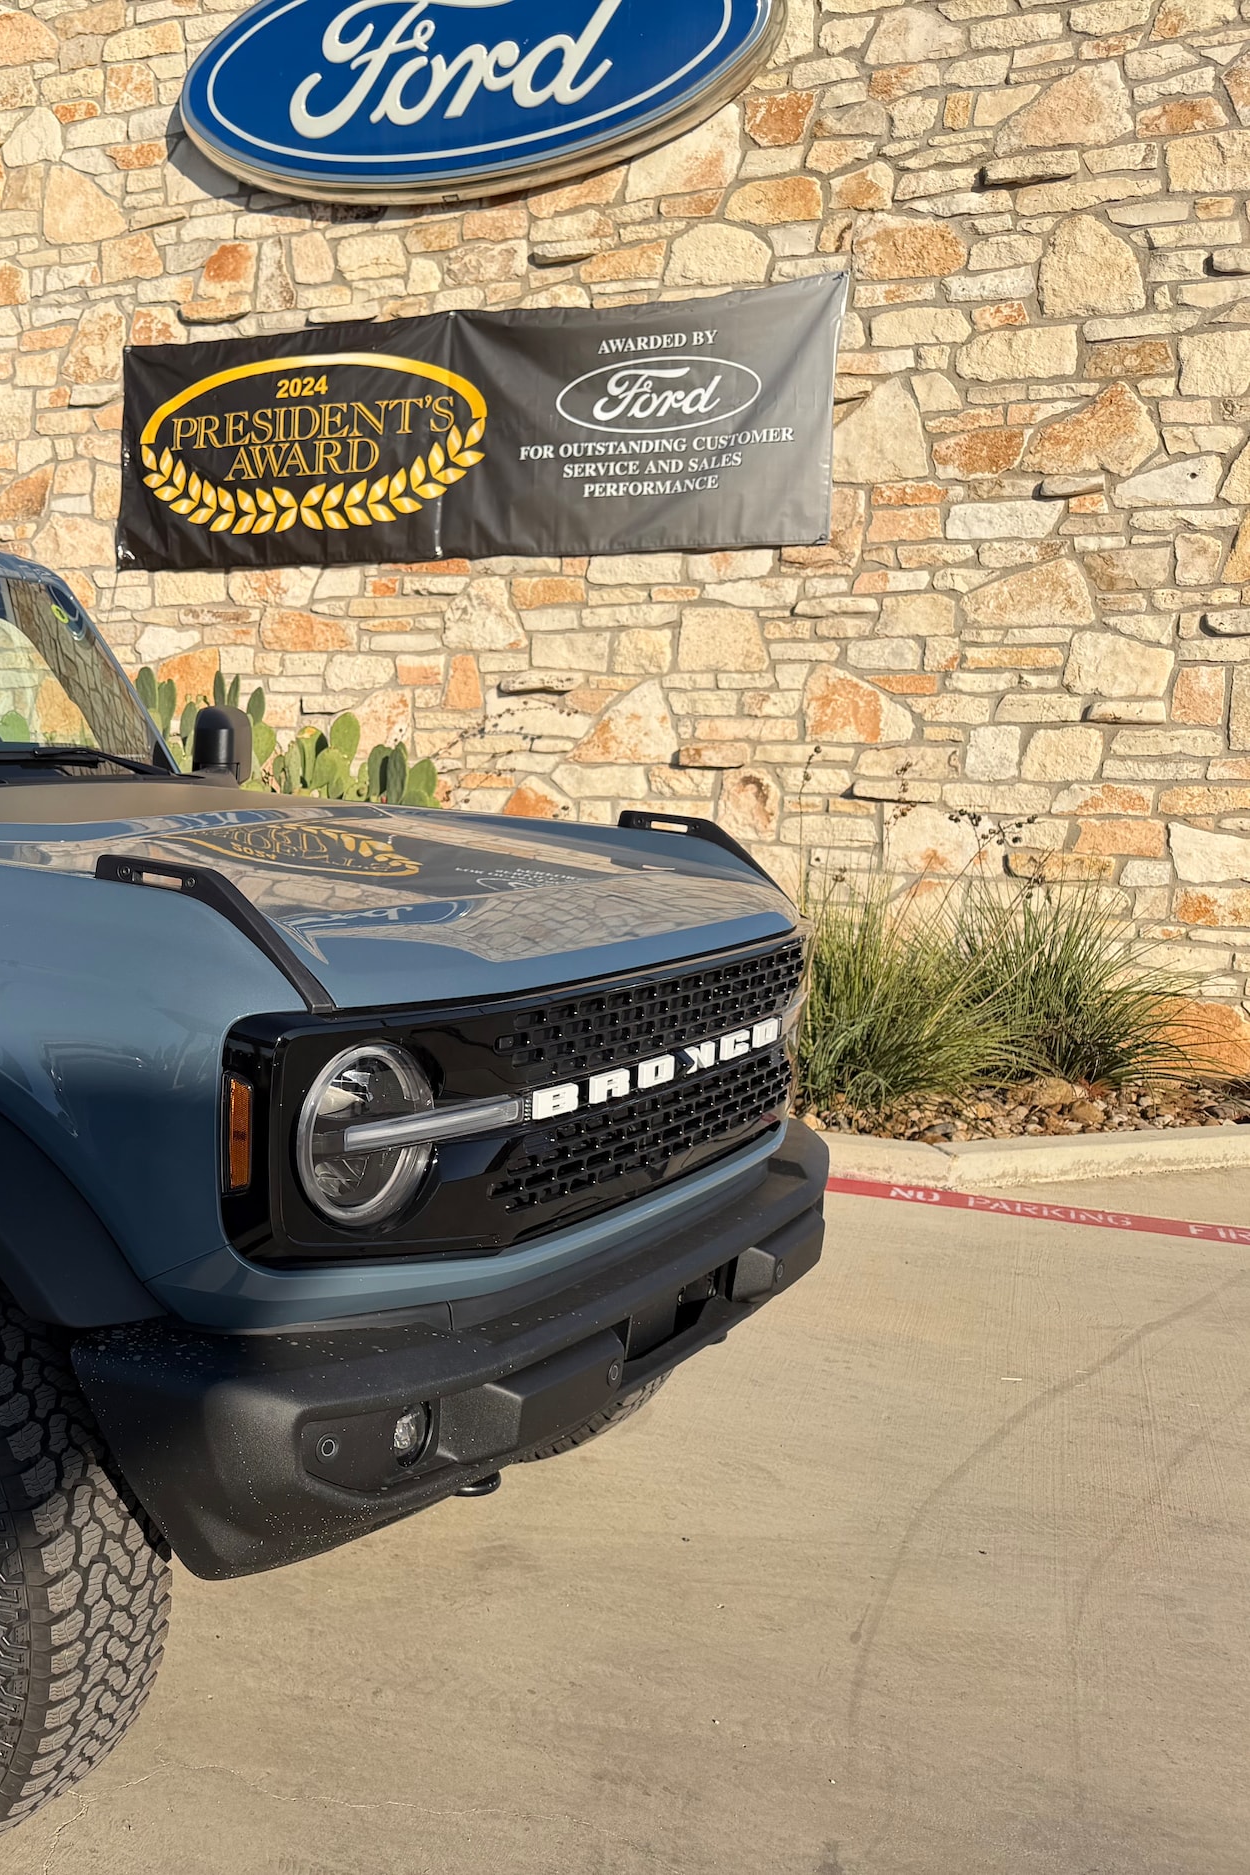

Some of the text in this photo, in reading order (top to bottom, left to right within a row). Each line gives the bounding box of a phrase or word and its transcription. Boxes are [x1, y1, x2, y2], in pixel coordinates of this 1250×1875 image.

[289, 0, 613, 139] Ford
[598, 330, 717, 354] AWARDED BY
[276, 375, 328, 399] 2024
[593, 366, 722, 421] Ford
[171, 394, 454, 451] PRESIDENT'S
[224, 437, 380, 481] AWARD
[519, 427, 794, 461] FOR OUTSTANDING CUSTOMER
[563, 452, 742, 478] SERVICE AND SALES
[583, 475, 719, 498] PERFORMANCE
[531, 1017, 780, 1121] BRONCO
[889, 1187, 940, 1202] NO
[968, 1197, 1132, 1227] PARKING
